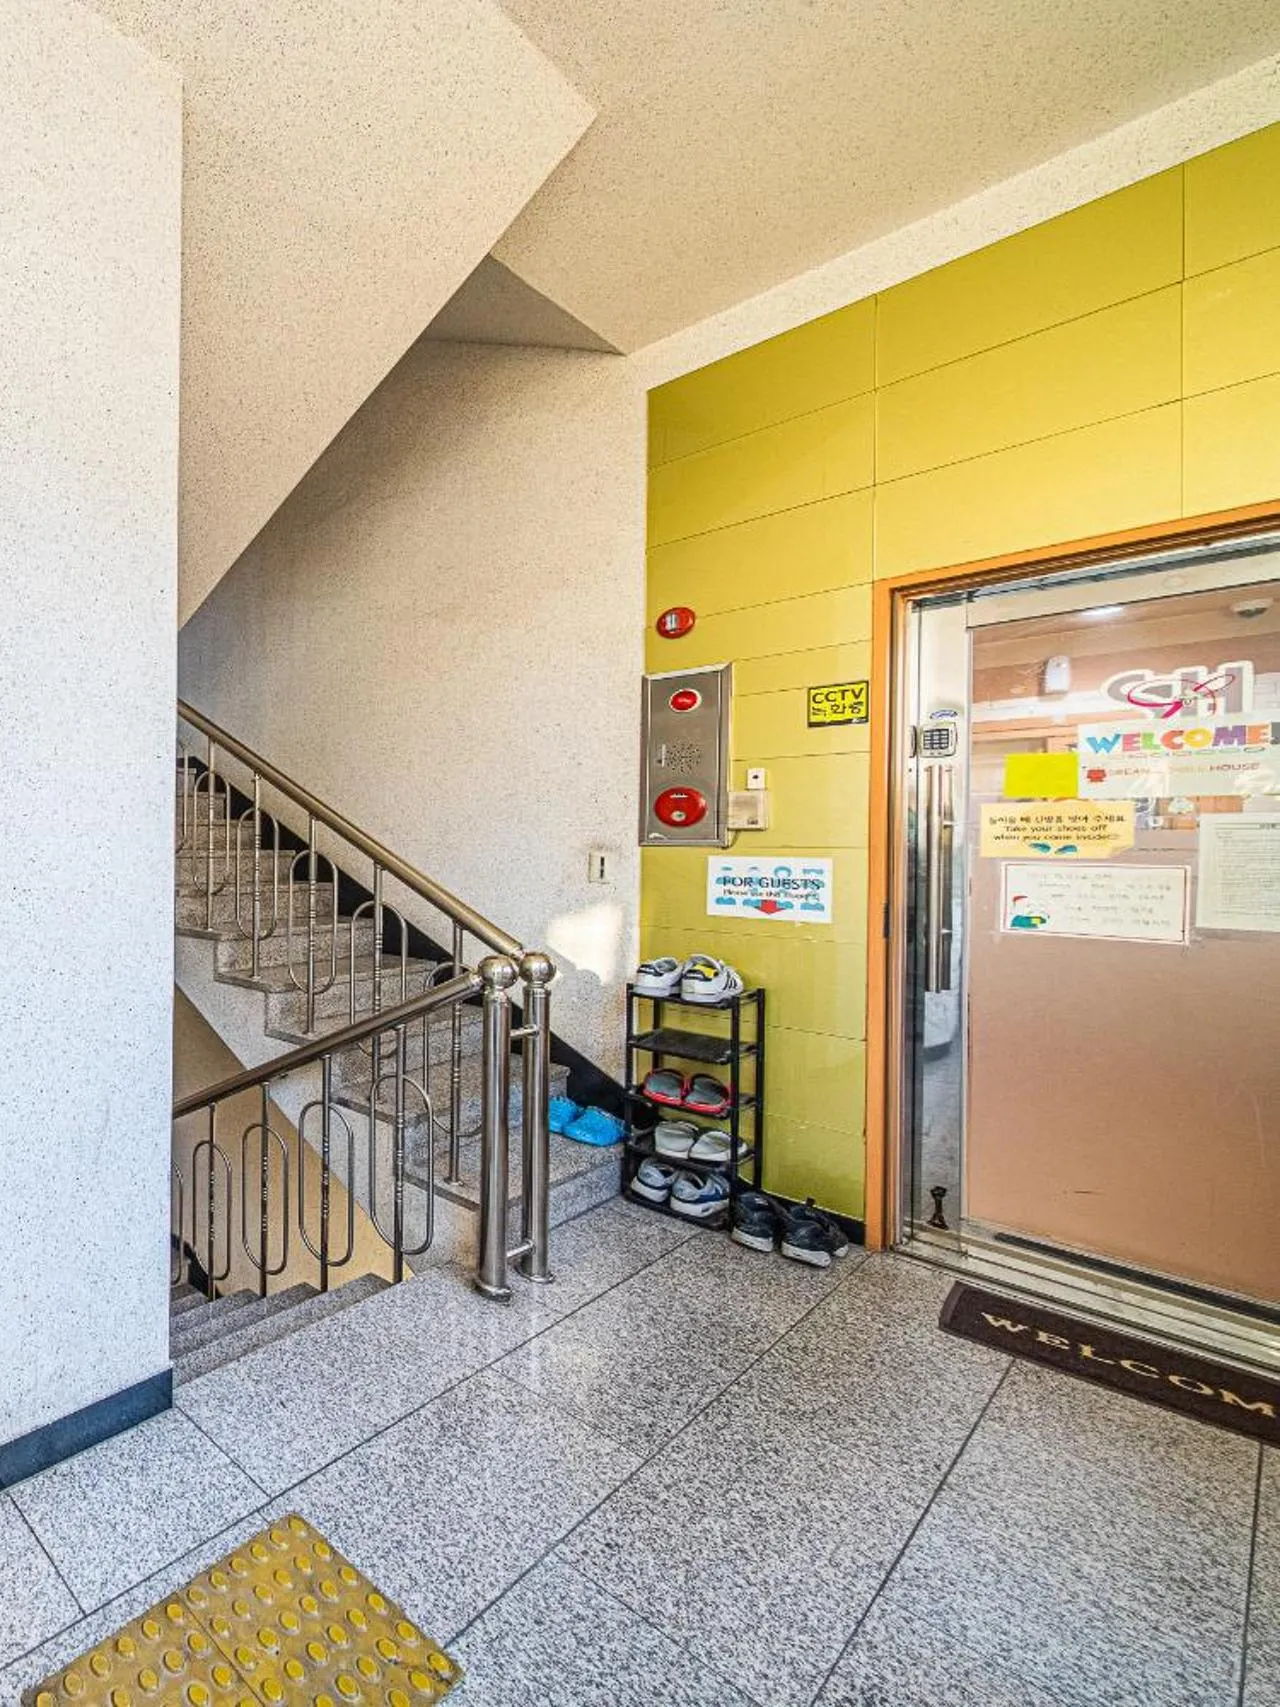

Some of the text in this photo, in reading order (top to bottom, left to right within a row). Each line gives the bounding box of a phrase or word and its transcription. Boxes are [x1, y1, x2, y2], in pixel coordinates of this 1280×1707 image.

[812, 688, 864, 704] CCTV
[1086, 723, 1271, 754] WELCOME
[1090, 824, 1108, 832] off
[723, 876, 820, 890] FOR GUESTS
